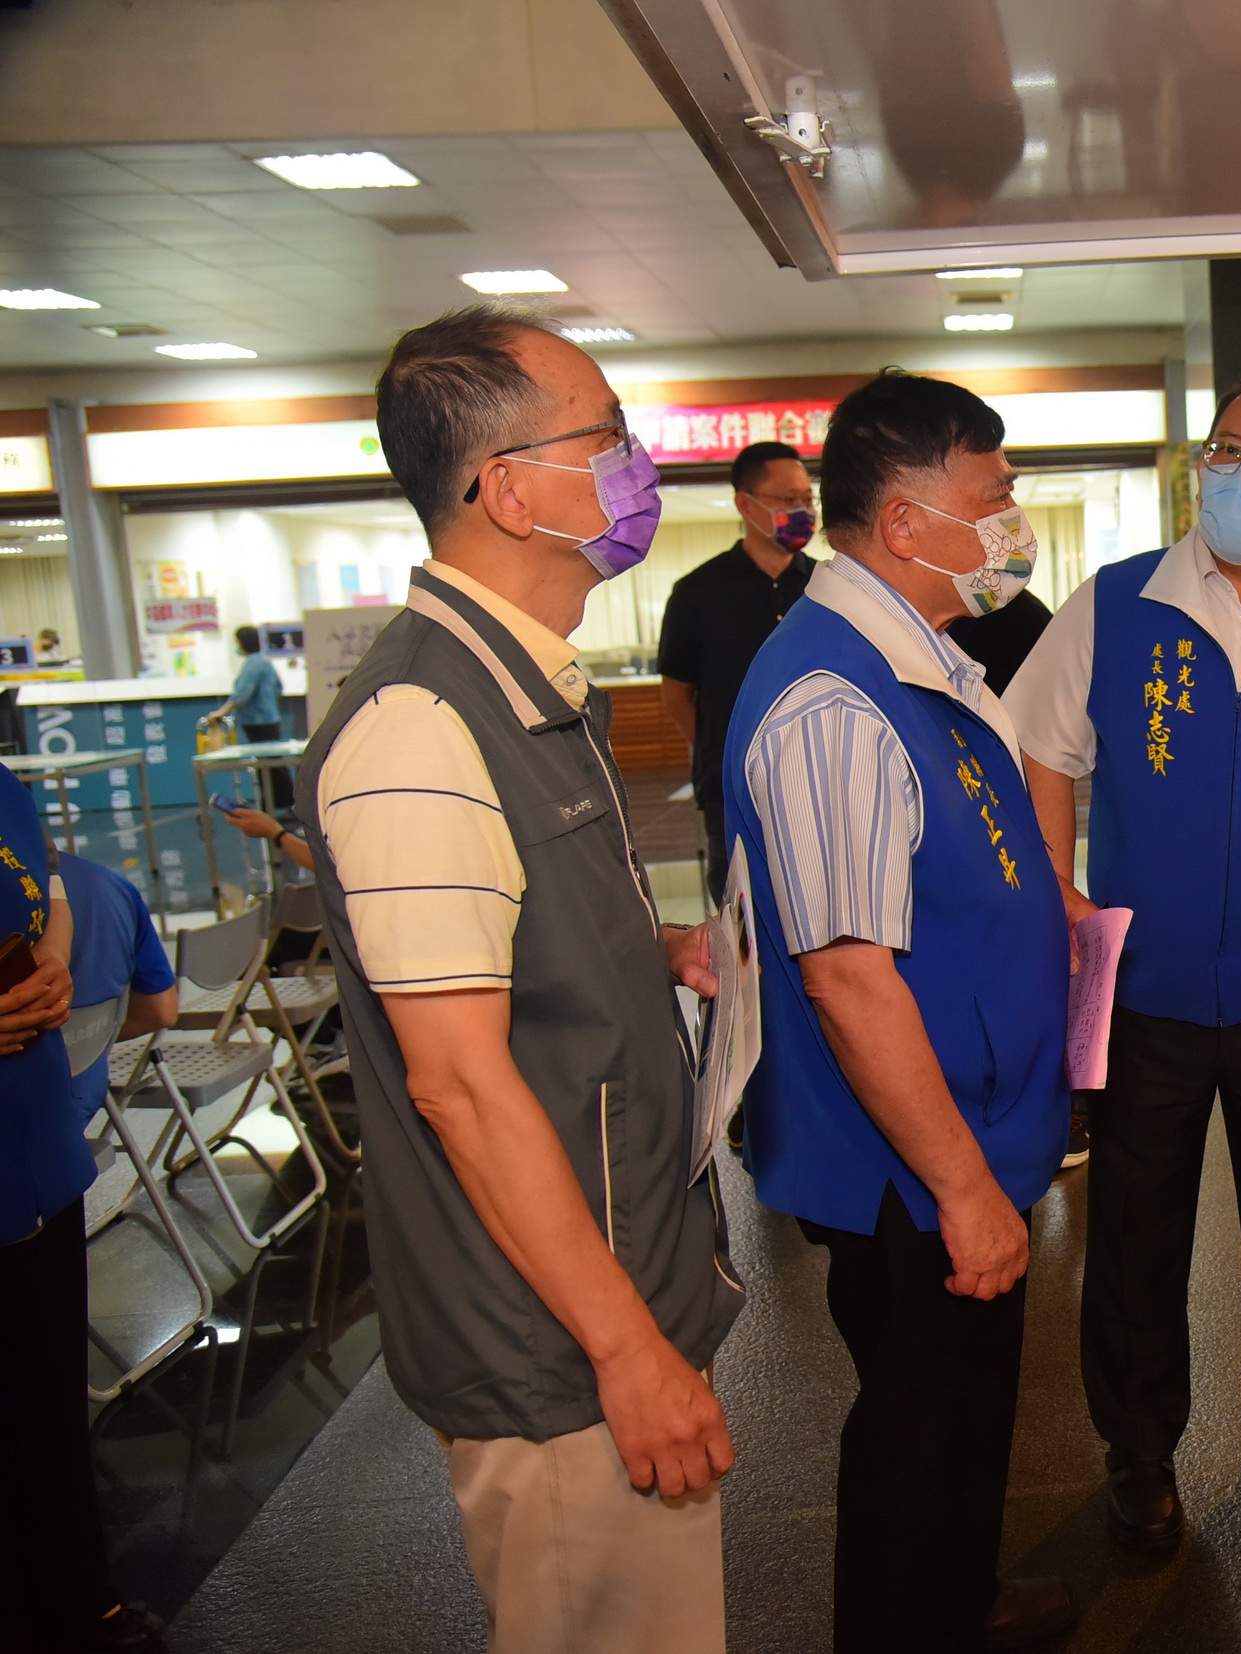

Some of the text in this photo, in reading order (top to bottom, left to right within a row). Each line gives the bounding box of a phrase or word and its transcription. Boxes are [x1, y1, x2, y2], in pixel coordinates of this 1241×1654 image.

[1144, 643, 1175, 776] 處長 陳志賢
[1174, 638, 1197, 714] 觀光處
